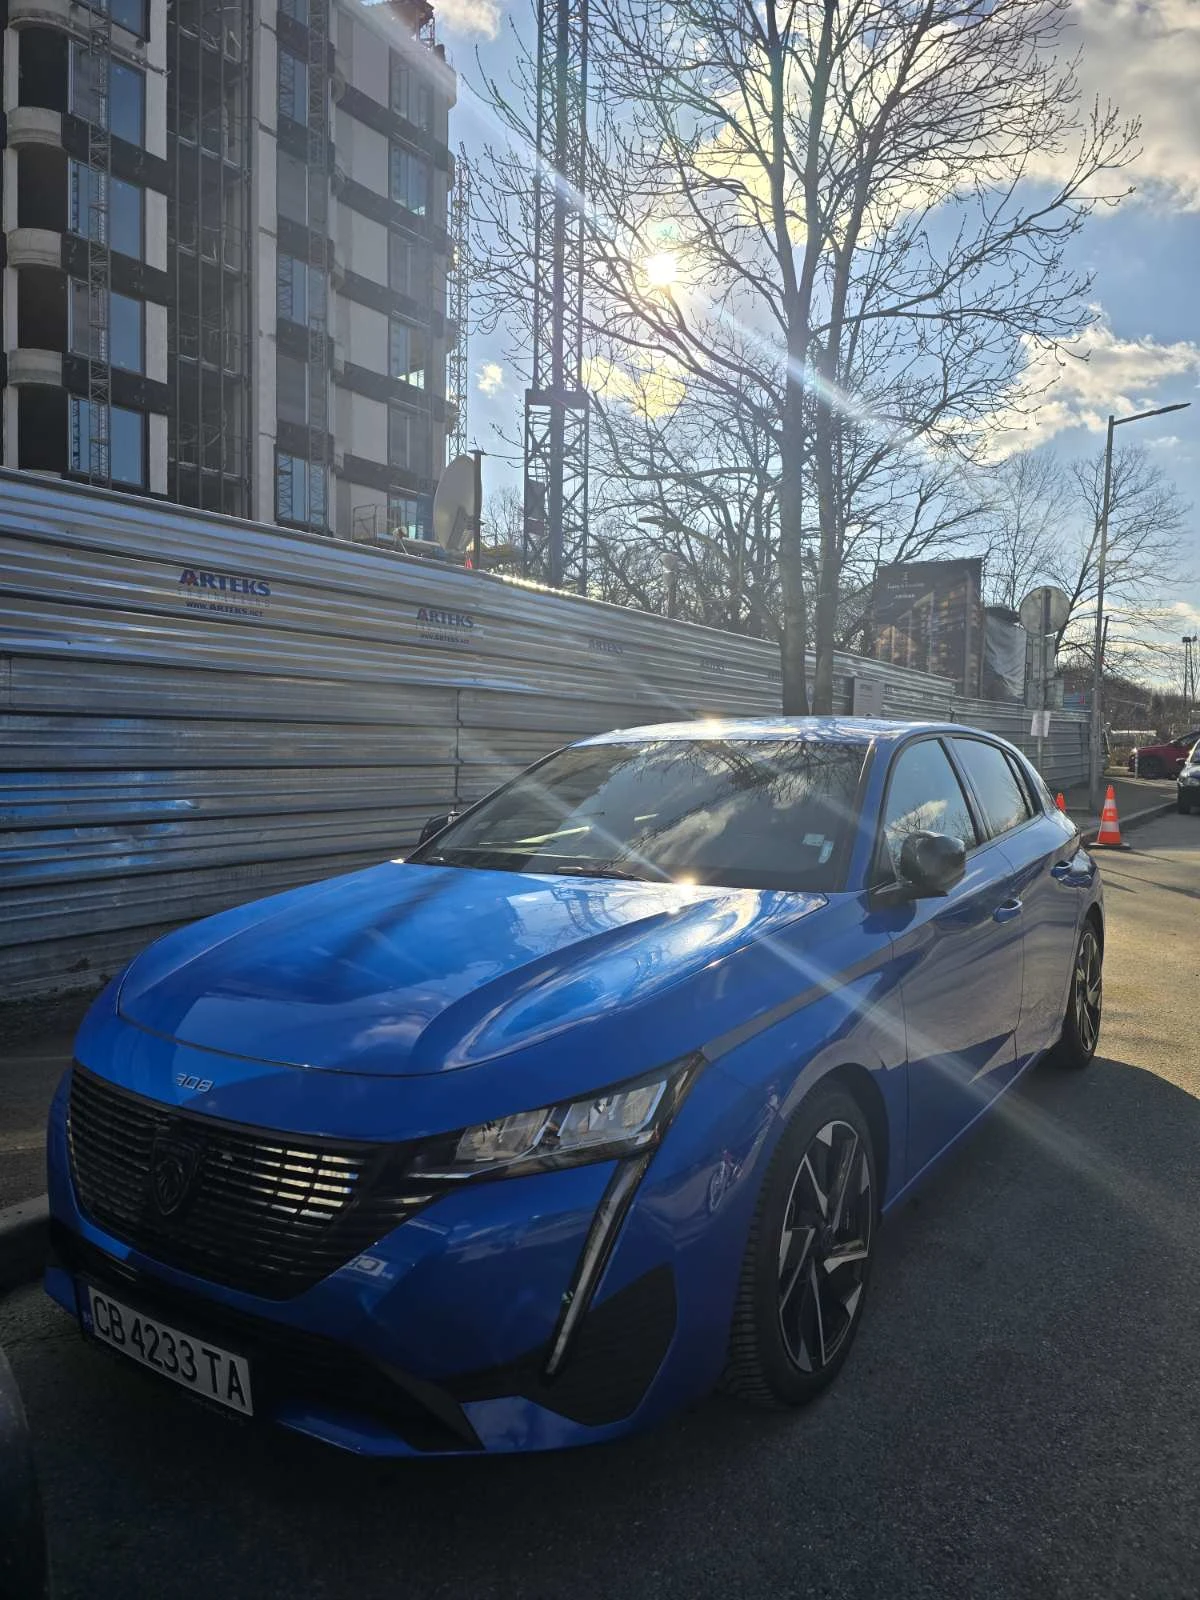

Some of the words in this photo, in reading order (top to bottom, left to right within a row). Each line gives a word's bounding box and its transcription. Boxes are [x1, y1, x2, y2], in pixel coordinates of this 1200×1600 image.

[179, 569, 271, 597] ARTEKS
[416, 608, 474, 628] ARTEKS
[176, 1073, 213, 1093] 308
[93, 1295, 126, 1346] CB
[131, 1318, 198, 1383] 4233
[203, 1350, 246, 1407] TA
